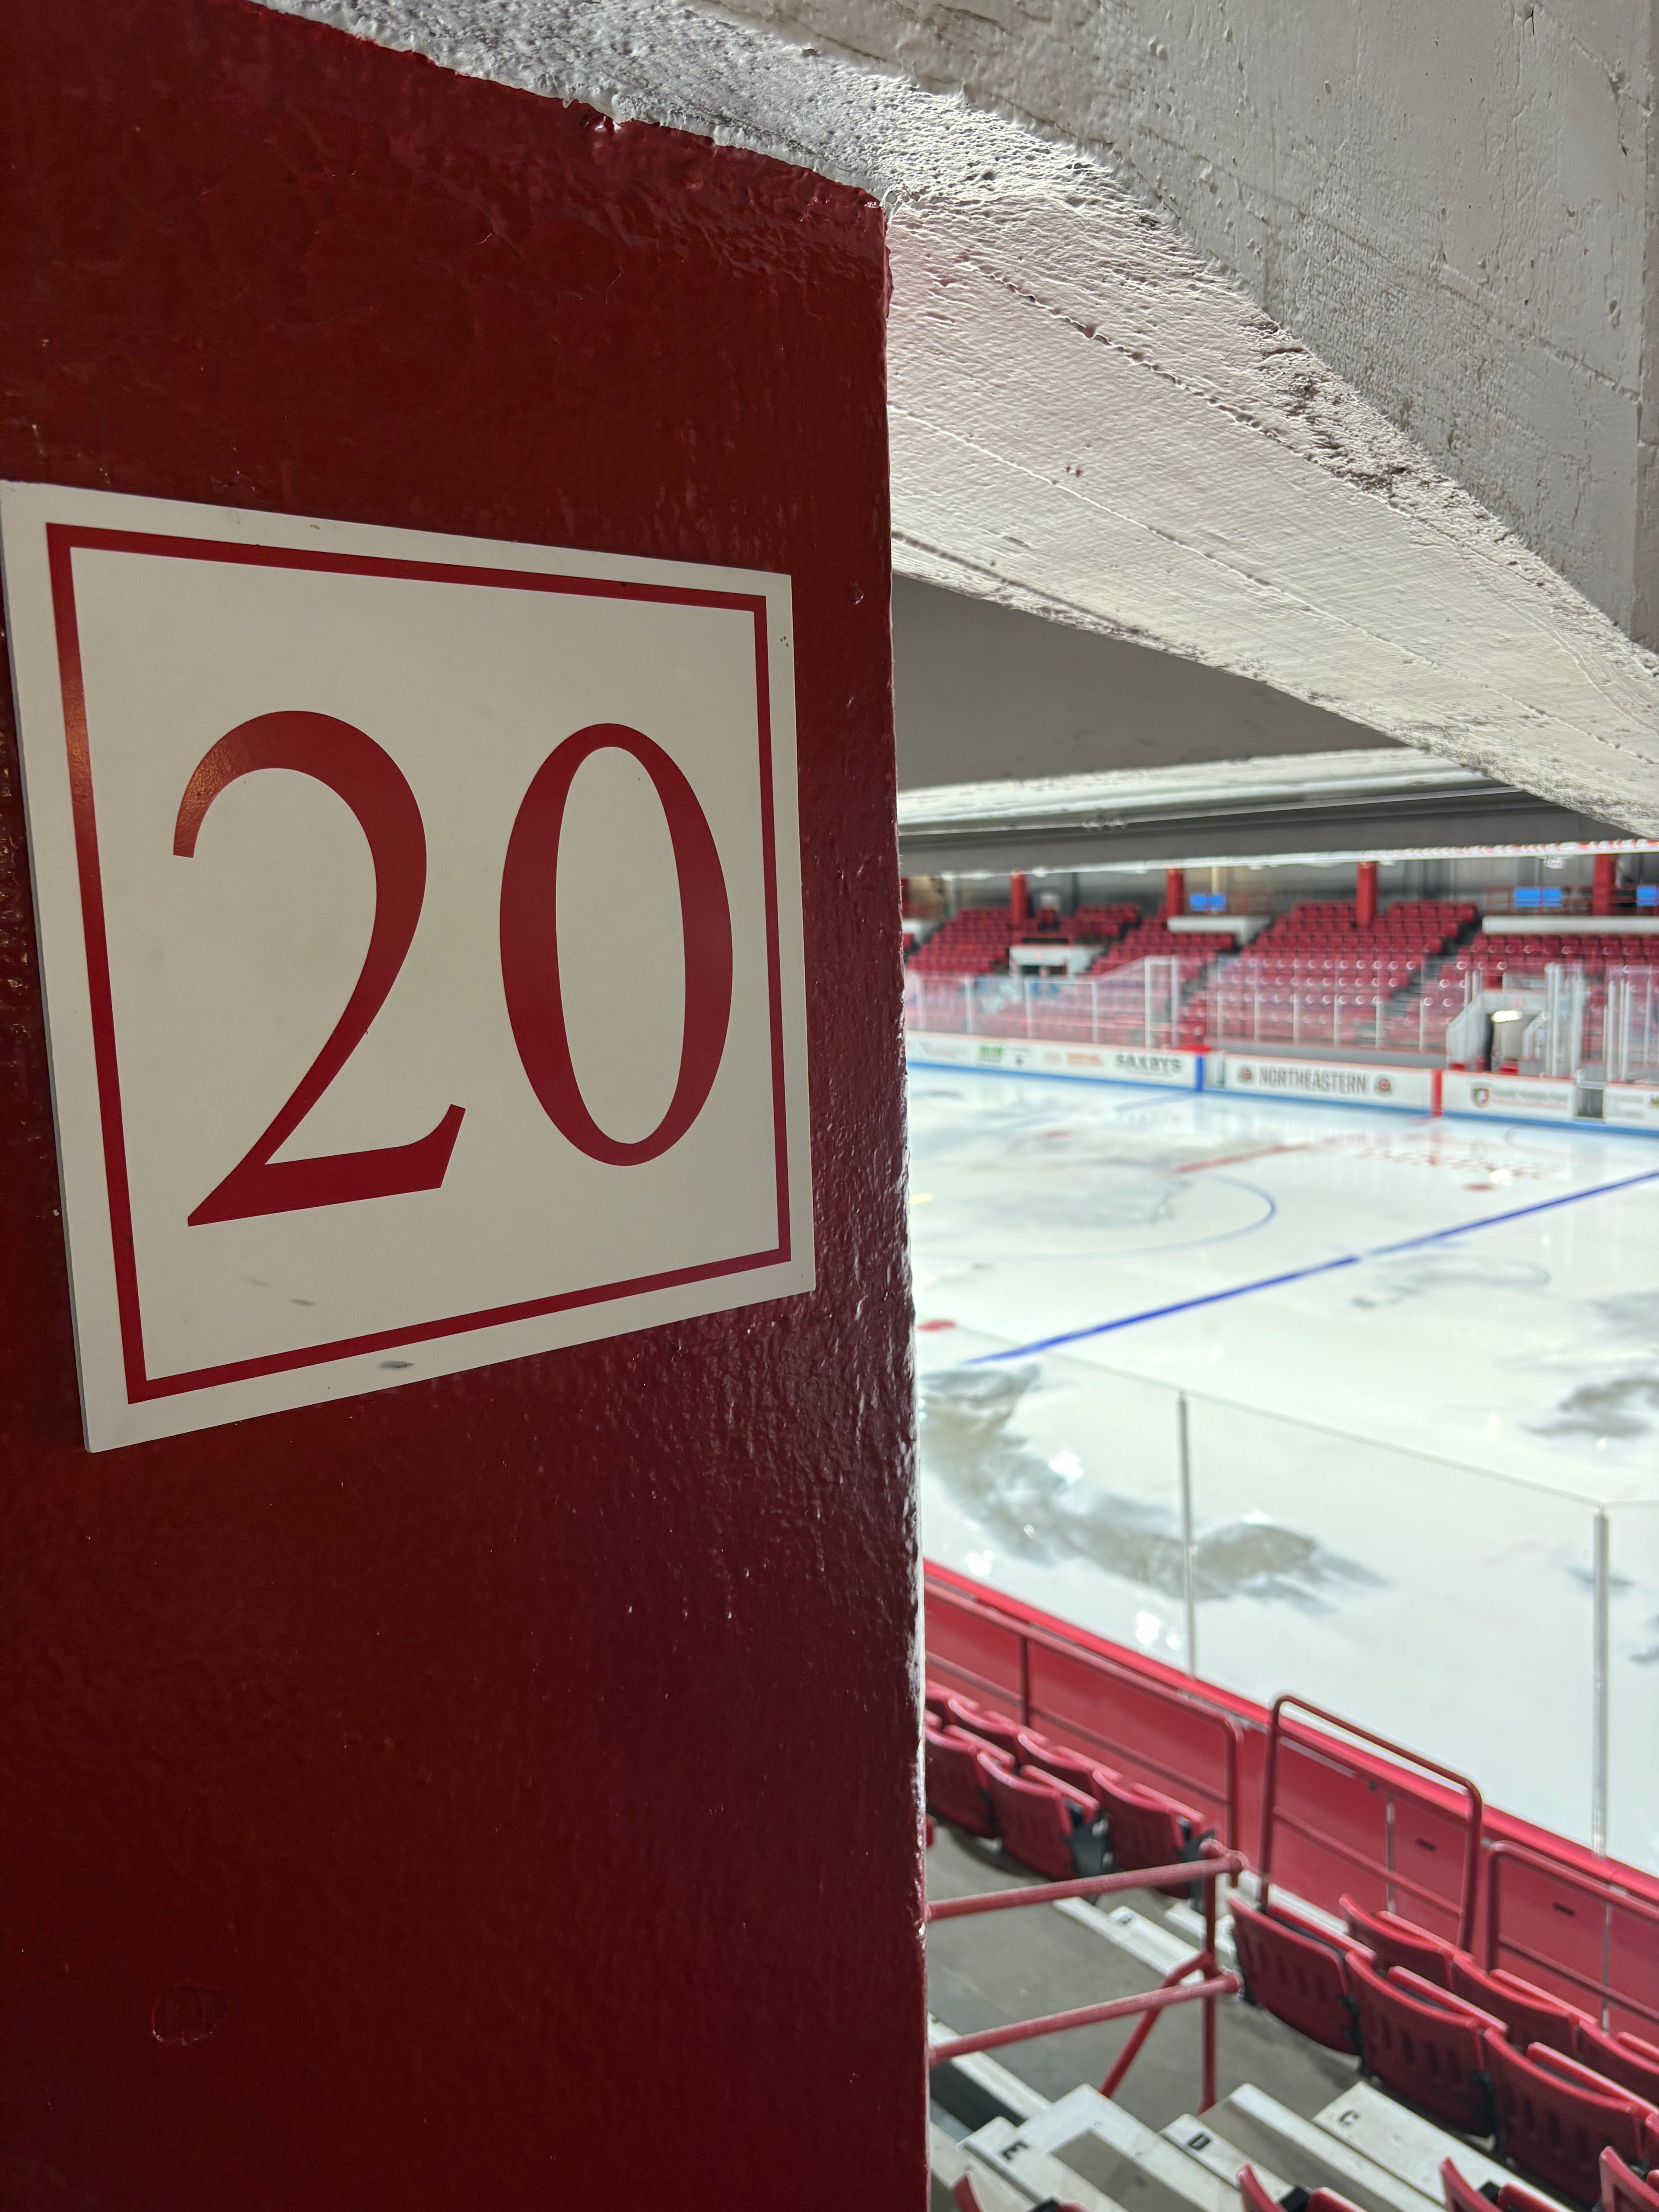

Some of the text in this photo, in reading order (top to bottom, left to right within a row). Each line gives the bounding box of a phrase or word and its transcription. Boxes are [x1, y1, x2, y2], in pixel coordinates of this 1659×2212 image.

[174, 711, 732, 1226] 20
[1259, 1065, 1367, 1095] NORTHEASTERN
[1001, 2140, 1028, 2160] E
[1188, 2132, 1211, 2150] D
